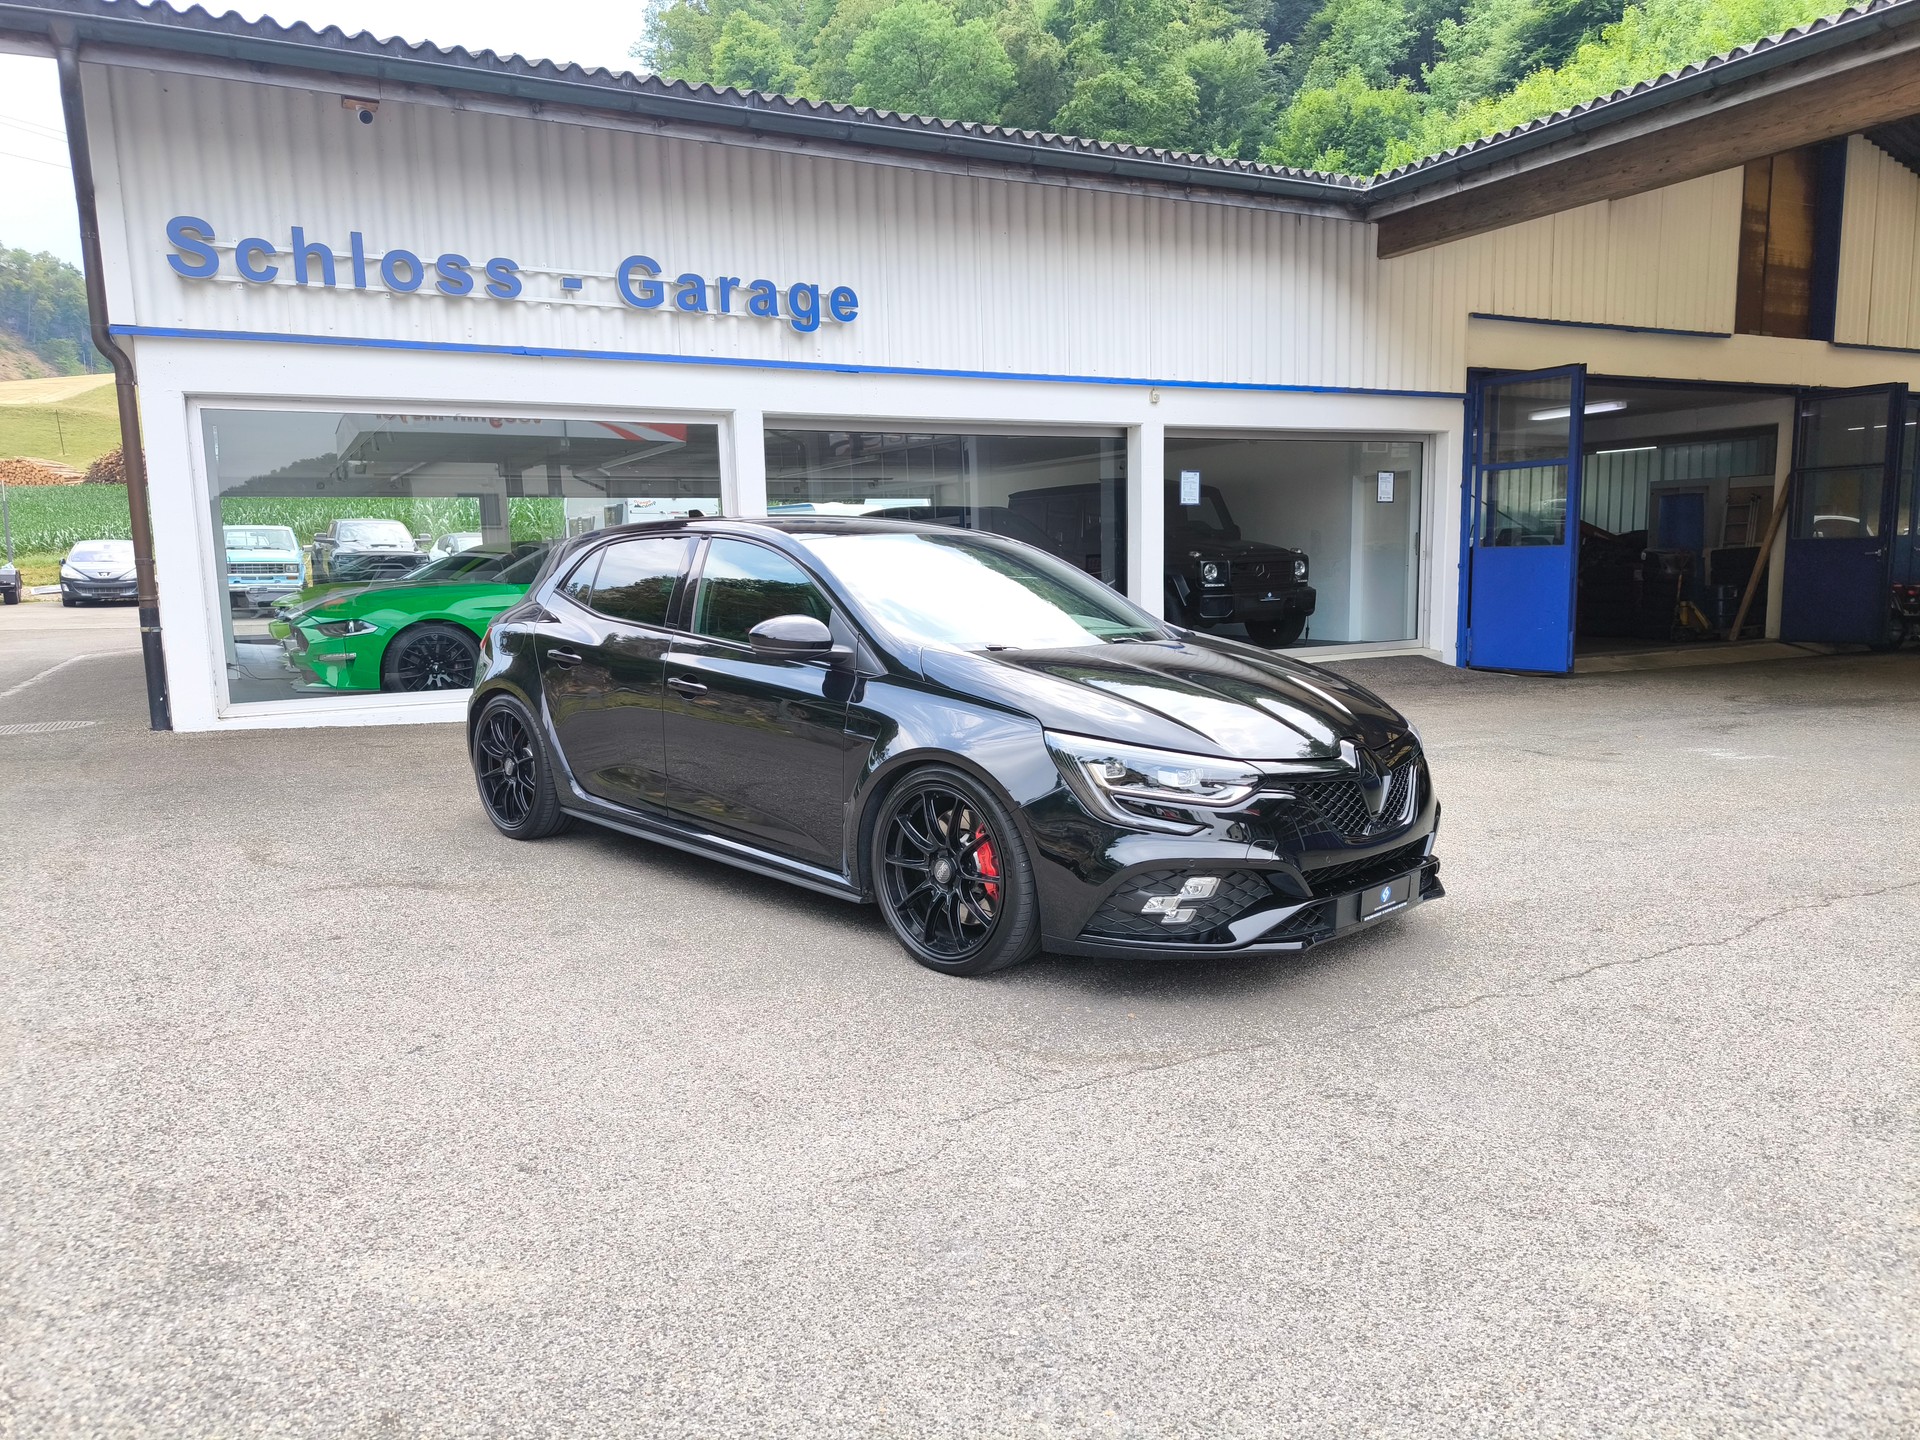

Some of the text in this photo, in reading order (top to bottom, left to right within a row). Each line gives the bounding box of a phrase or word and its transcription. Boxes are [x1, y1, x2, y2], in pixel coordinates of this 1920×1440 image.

[166, 216, 859, 333] Schloss - Garage
